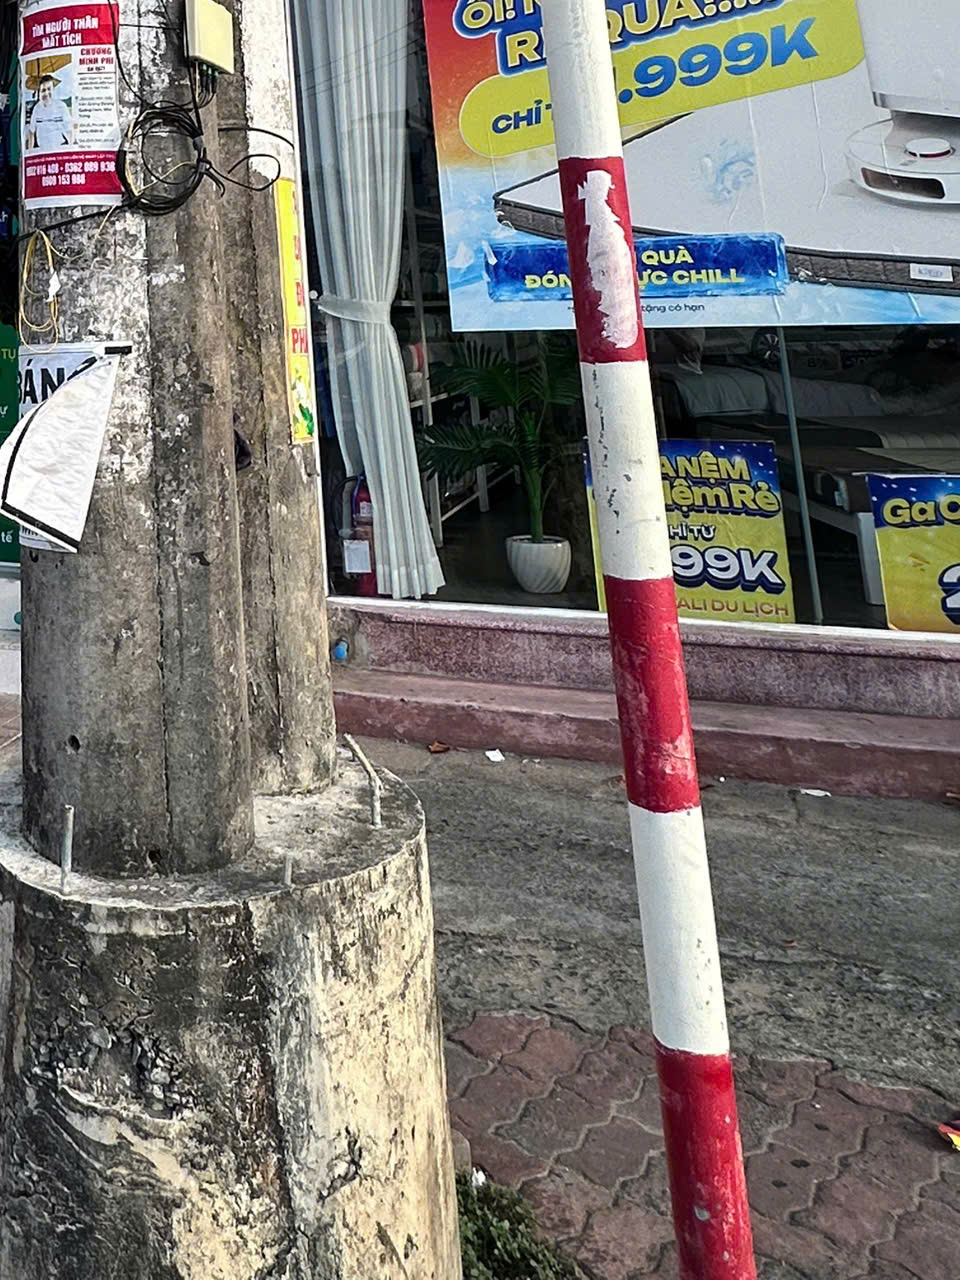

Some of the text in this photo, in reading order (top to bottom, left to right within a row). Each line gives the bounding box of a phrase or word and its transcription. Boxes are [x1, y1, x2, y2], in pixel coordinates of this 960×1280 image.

[613, 17, 820, 104] .999K
[641, 245, 695, 265] QUÀ
[673, 267, 746, 286] CHILL
[669, 302, 681, 312] có
[684, 303, 705, 314] hạn
[1, 348, 17, 363] TỤ
[883, 497, 937, 525] Ga
[1, 530, 14, 544] tế
[669, 522, 689, 540] HỈ
[677, 597, 790, 618] ALI DU LỊCH
